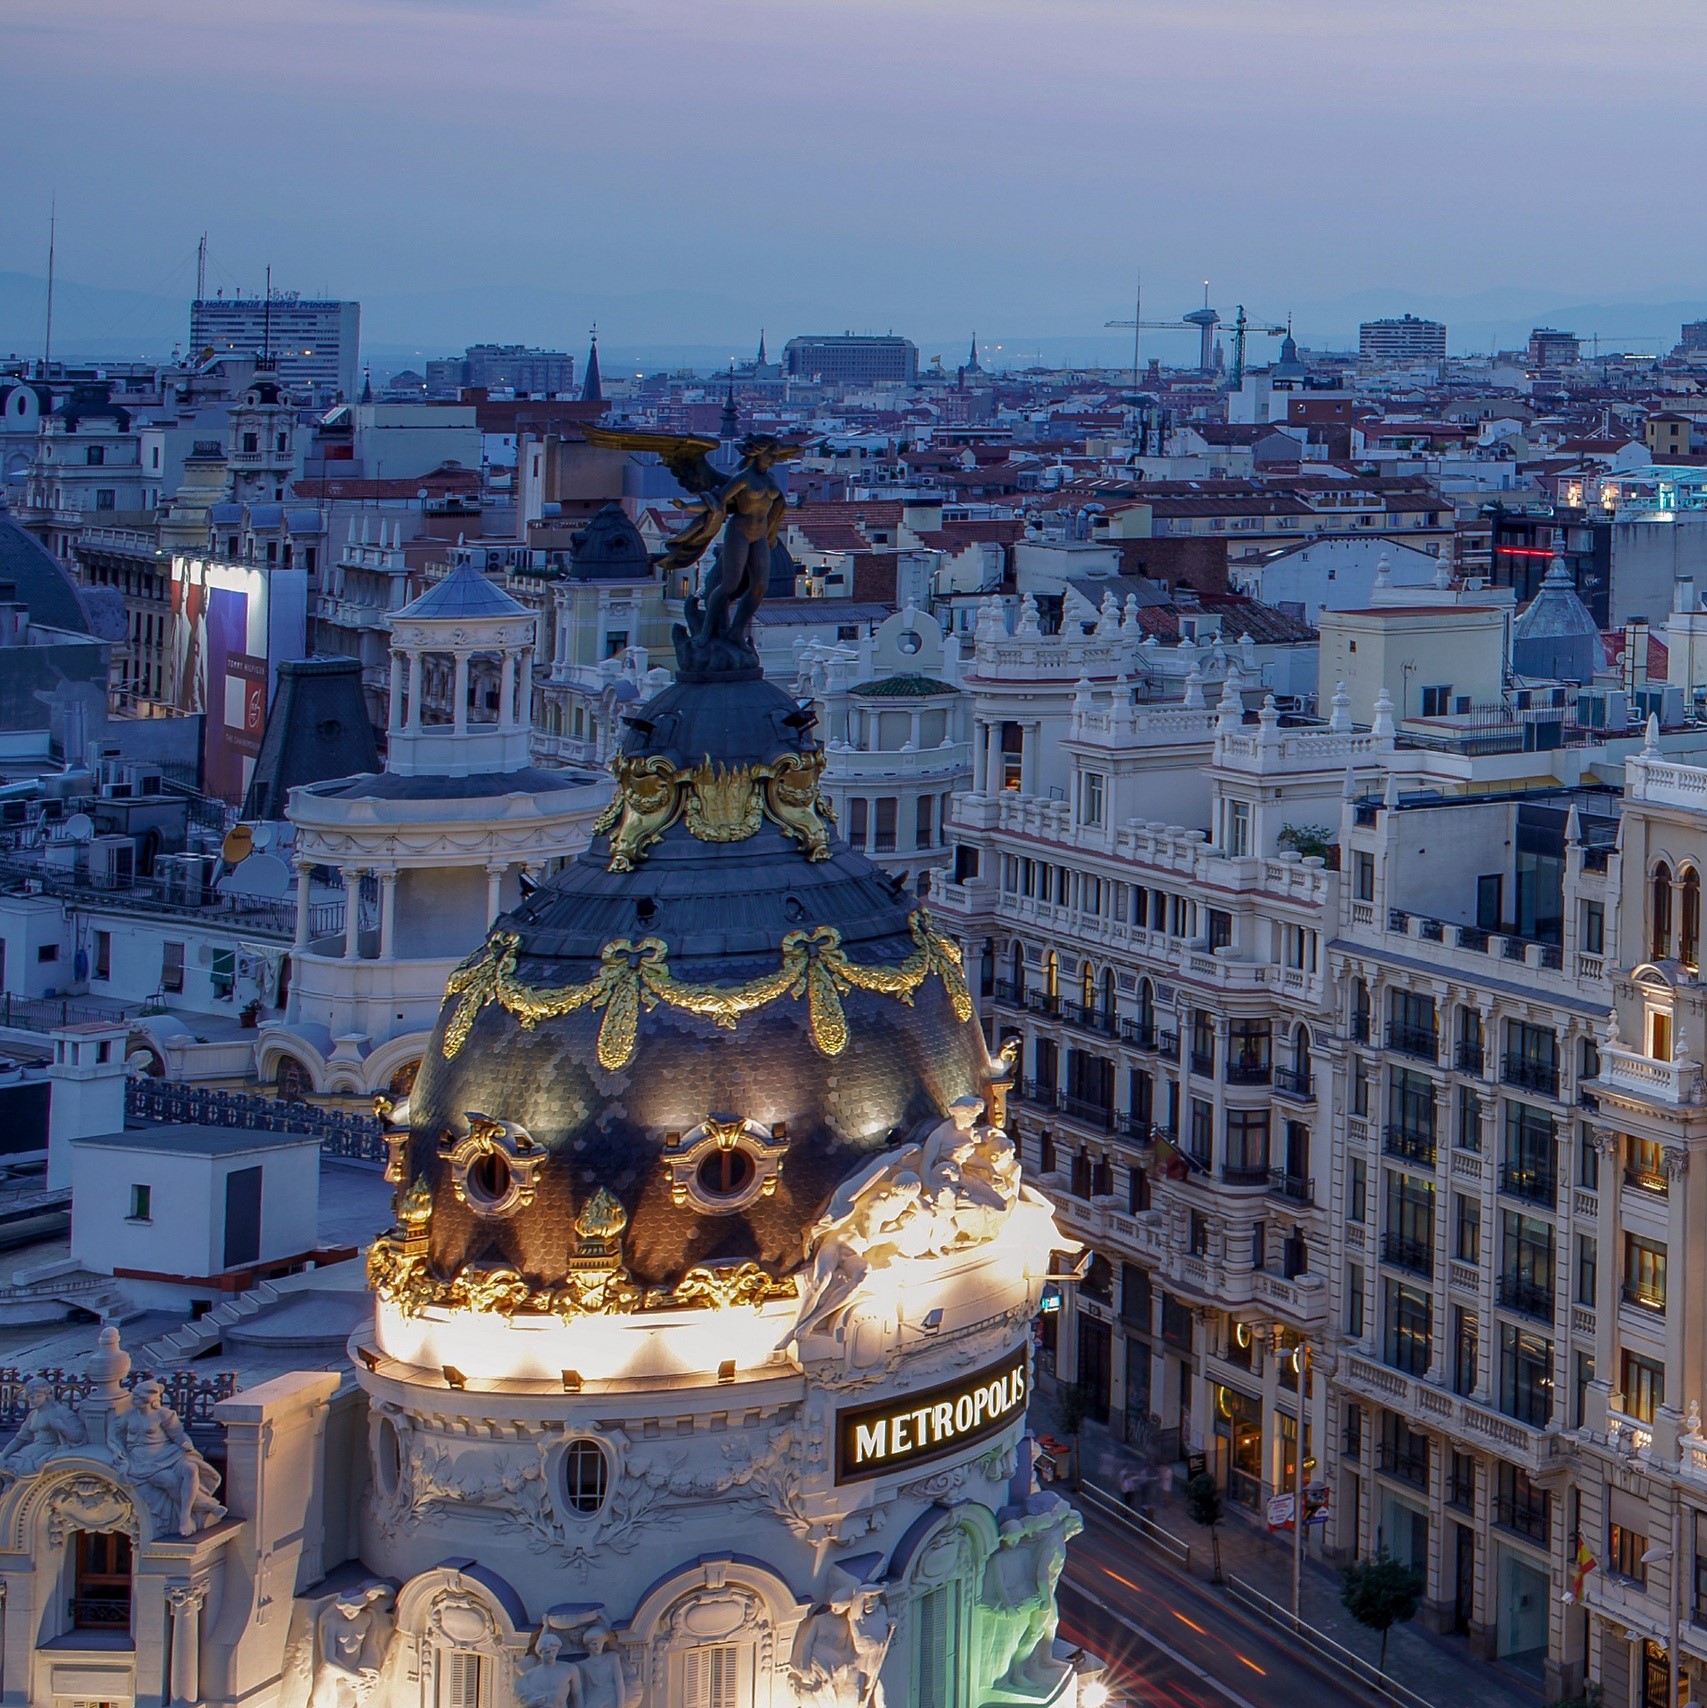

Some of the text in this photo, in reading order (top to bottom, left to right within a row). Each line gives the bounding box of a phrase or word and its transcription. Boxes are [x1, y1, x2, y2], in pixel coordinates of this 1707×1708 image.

[204, 300, 230, 309] Hotel
[299, 301, 340, 310] Princesa
[855, 1364, 1025, 1463] METROPOLIS
